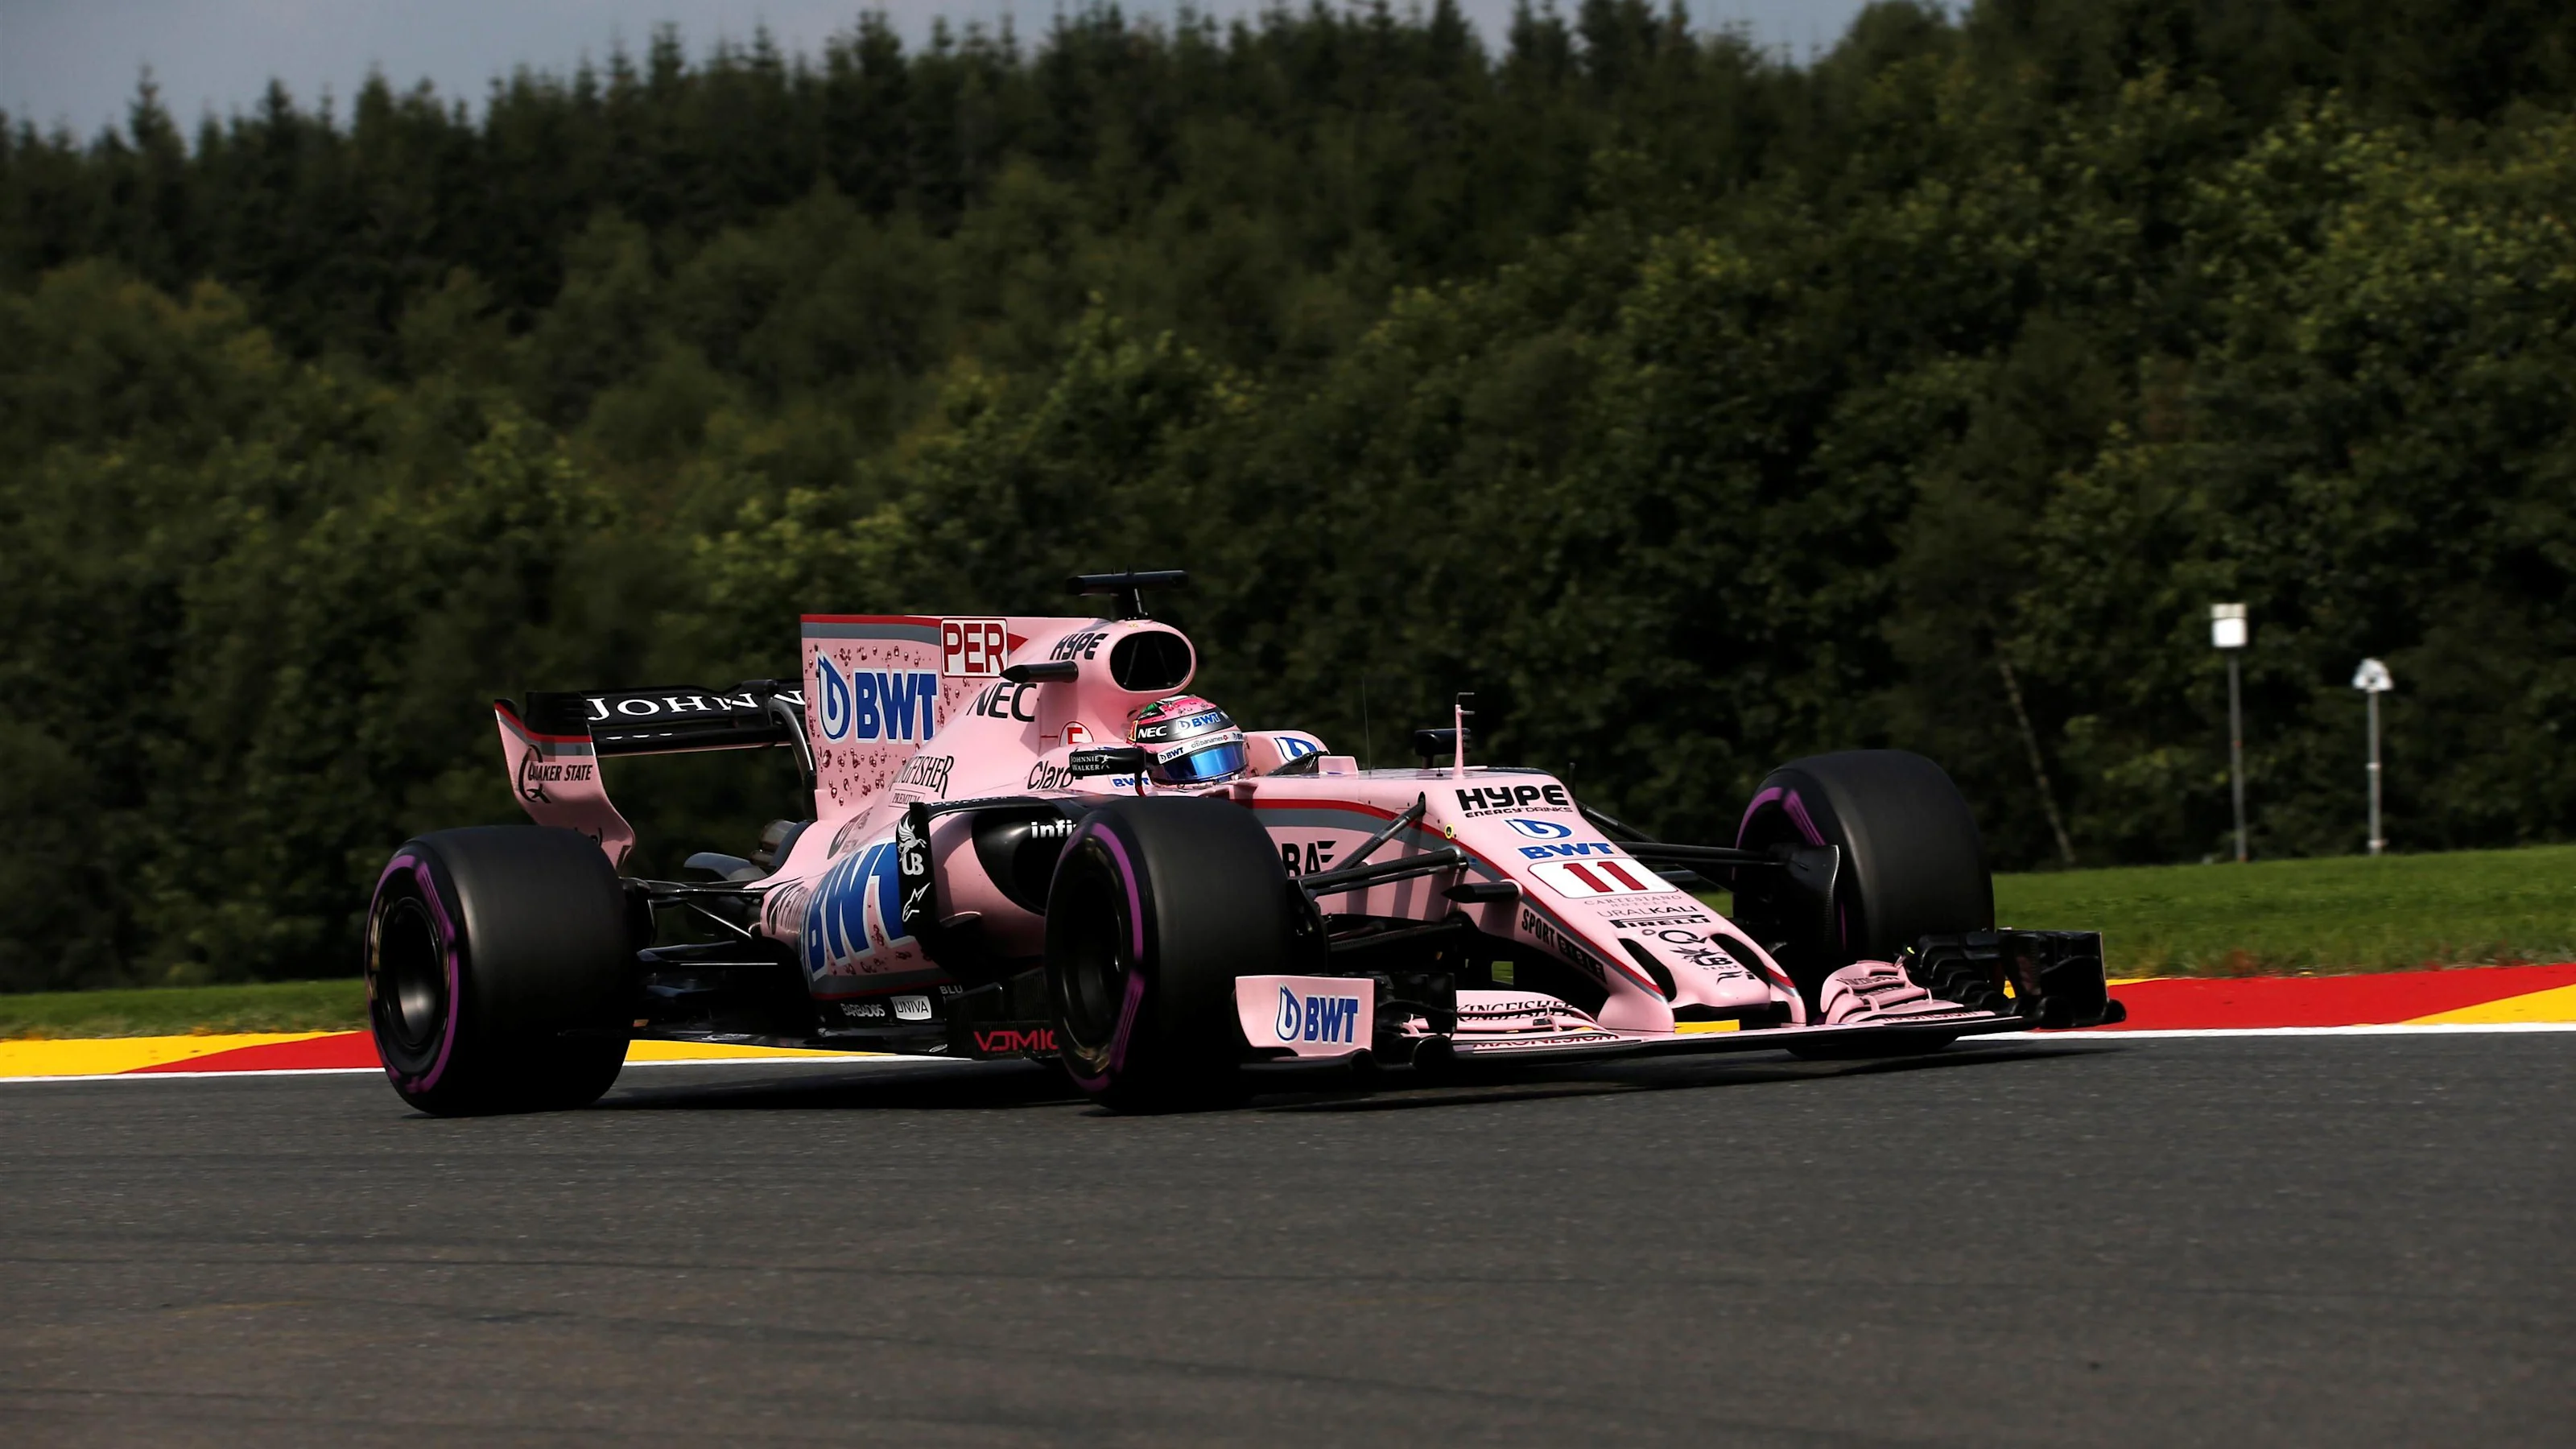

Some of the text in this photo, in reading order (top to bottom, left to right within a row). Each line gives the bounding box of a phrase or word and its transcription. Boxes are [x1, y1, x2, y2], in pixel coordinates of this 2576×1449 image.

[942, 623, 1005, 673] PER
[1049, 633, 1109, 660] HYPE
[854, 671, 938, 741] BWT
[966, 682, 1037, 722] NEC
[1191, 712, 1220, 728] BWT
[1138, 725, 1167, 739] NEC
[1071, 755, 1099, 764] JOHNNIE
[1166, 747, 1183, 759] BWT
[564, 765, 593, 782] STATE
[1027, 759, 1074, 790] Claro
[1455, 785, 1569, 811] HYPE
[1465, 807, 1521, 818] ENERGY
[1031, 819, 1077, 838] infi
[1518, 843, 1614, 860] BWT
[1563, 861, 1649, 893] 11
[807, 840, 903, 975] BWT
[1583, 894, 1682, 906] CARTESIANO
[1597, 906, 1699, 918] URALKALI
[1521, 908, 1555, 948] SPORT
[1608, 914, 1711, 928] PIRELLI
[840, 1002, 886, 1017] BARBADOS
[894, 1000, 929, 1013] UNIVA
[1304, 996, 1359, 1042] BWT
